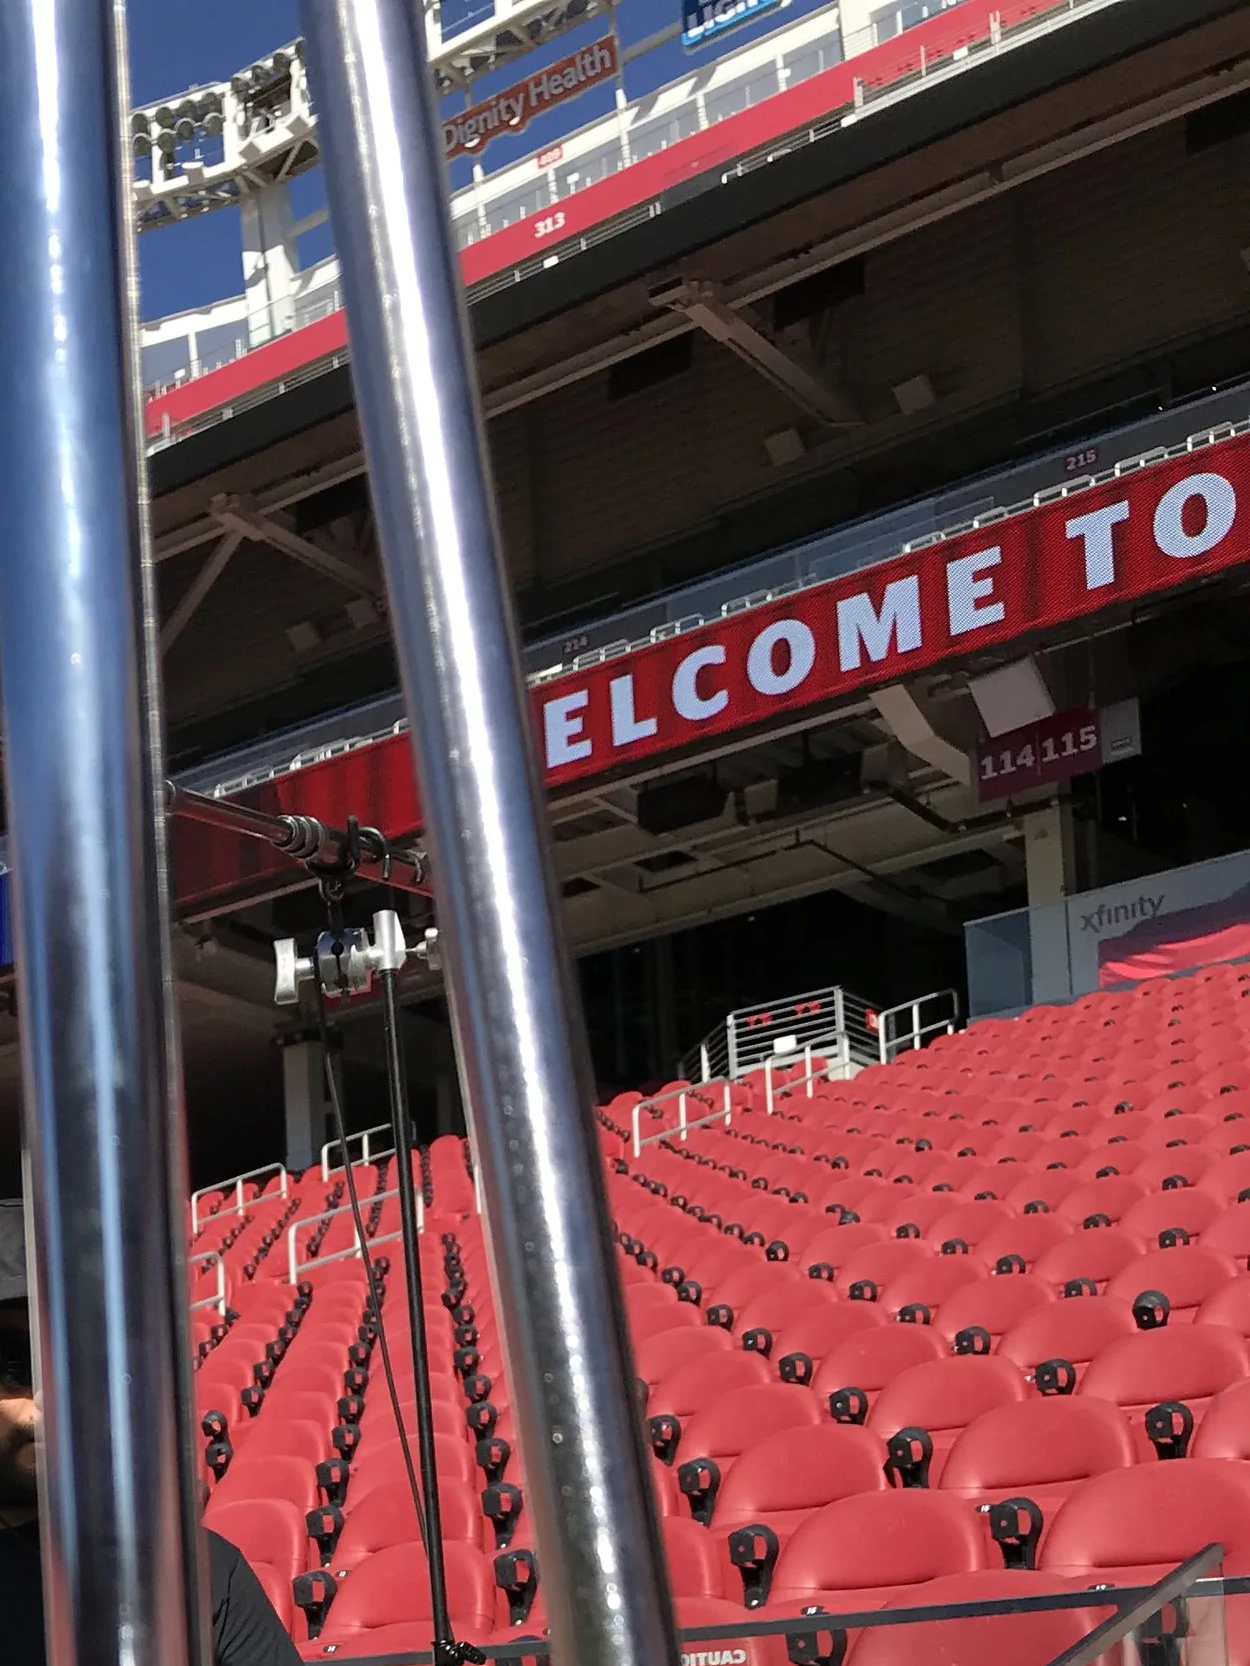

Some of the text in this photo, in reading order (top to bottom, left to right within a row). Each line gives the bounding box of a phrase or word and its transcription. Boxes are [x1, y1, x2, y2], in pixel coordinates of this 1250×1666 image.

[442, 44, 611, 148] Dignity Health
[534, 212, 566, 239] 313
[1066, 450, 1097, 471] 215
[542, 472, 1238, 768] ELCOME TO
[980, 725, 1098, 780] 114 115
[1080, 895, 1166, 933] xfinity
